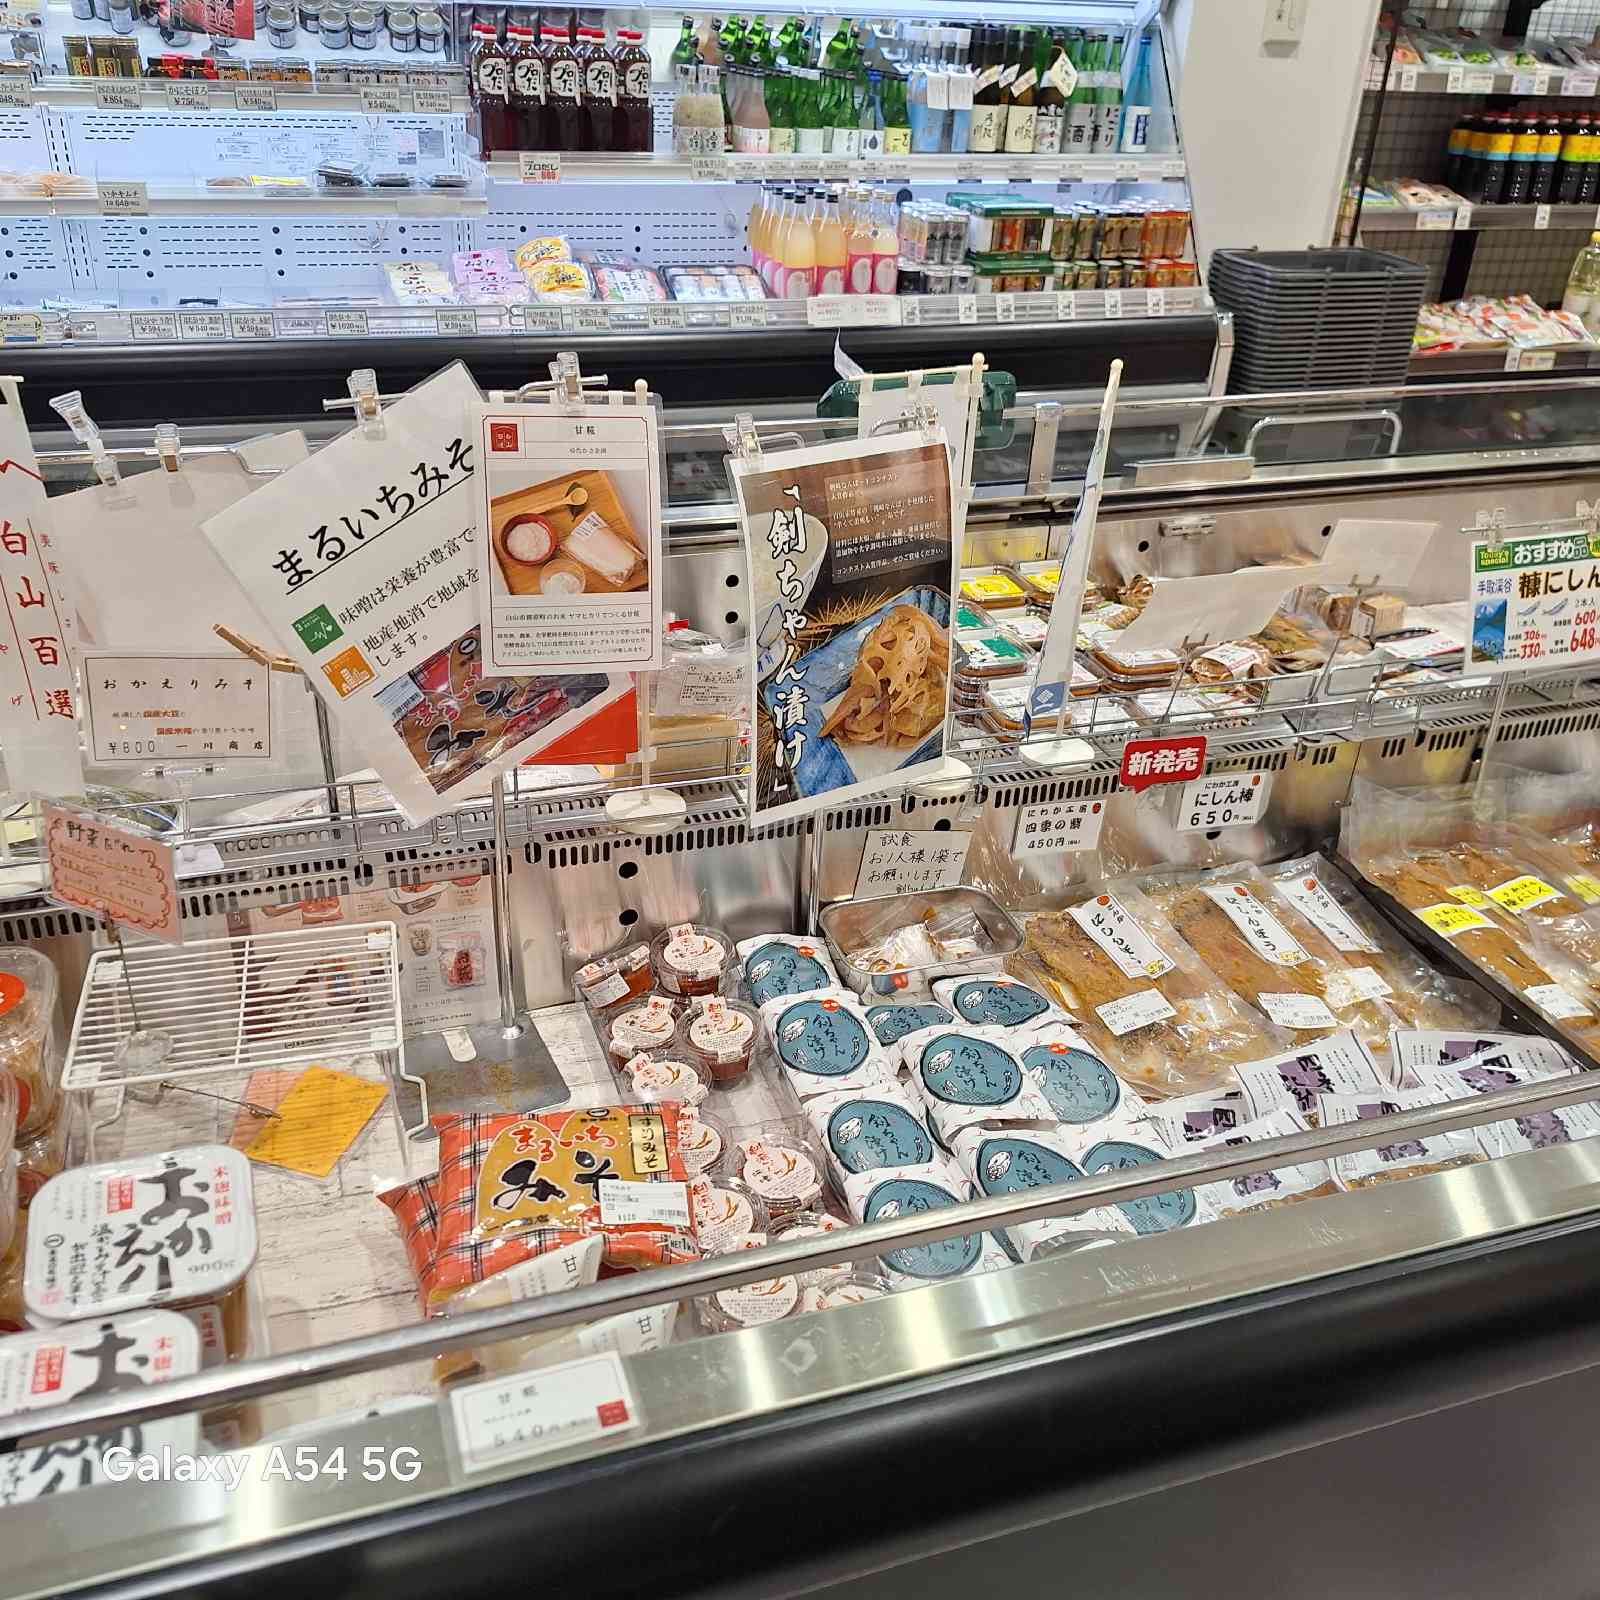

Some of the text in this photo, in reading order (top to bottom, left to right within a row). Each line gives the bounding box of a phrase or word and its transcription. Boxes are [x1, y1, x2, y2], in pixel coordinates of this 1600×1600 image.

[272, 438, 475, 587] まるいちみそ
[338, 526, 478, 626] 味噌は栄養が豊富で
[0, 520, 74, 720] 白山百選
[362, 567, 481, 653] 地産地消で地域を
[376, 633, 429, 667] します。
[103, 677, 254, 691] おかえりみそ
[108, 739, 265, 754] ¥800 一川商店
[1127, 746, 1201, 777] 新発売
[1027, 804, 1088, 818] にわか工房
[1194, 787, 1255, 808] にしん棒
[880, 831, 915, 847] 試食
[1027, 836, 1065, 849] 450円
[867, 868, 947, 884] お願いします
[510, 1124, 616, 1162] まるいち
[638, 1116, 660, 1169] すりみそ
[492, 1149, 620, 1211] みそ
[113, 1167, 212, 1293] おかえり
